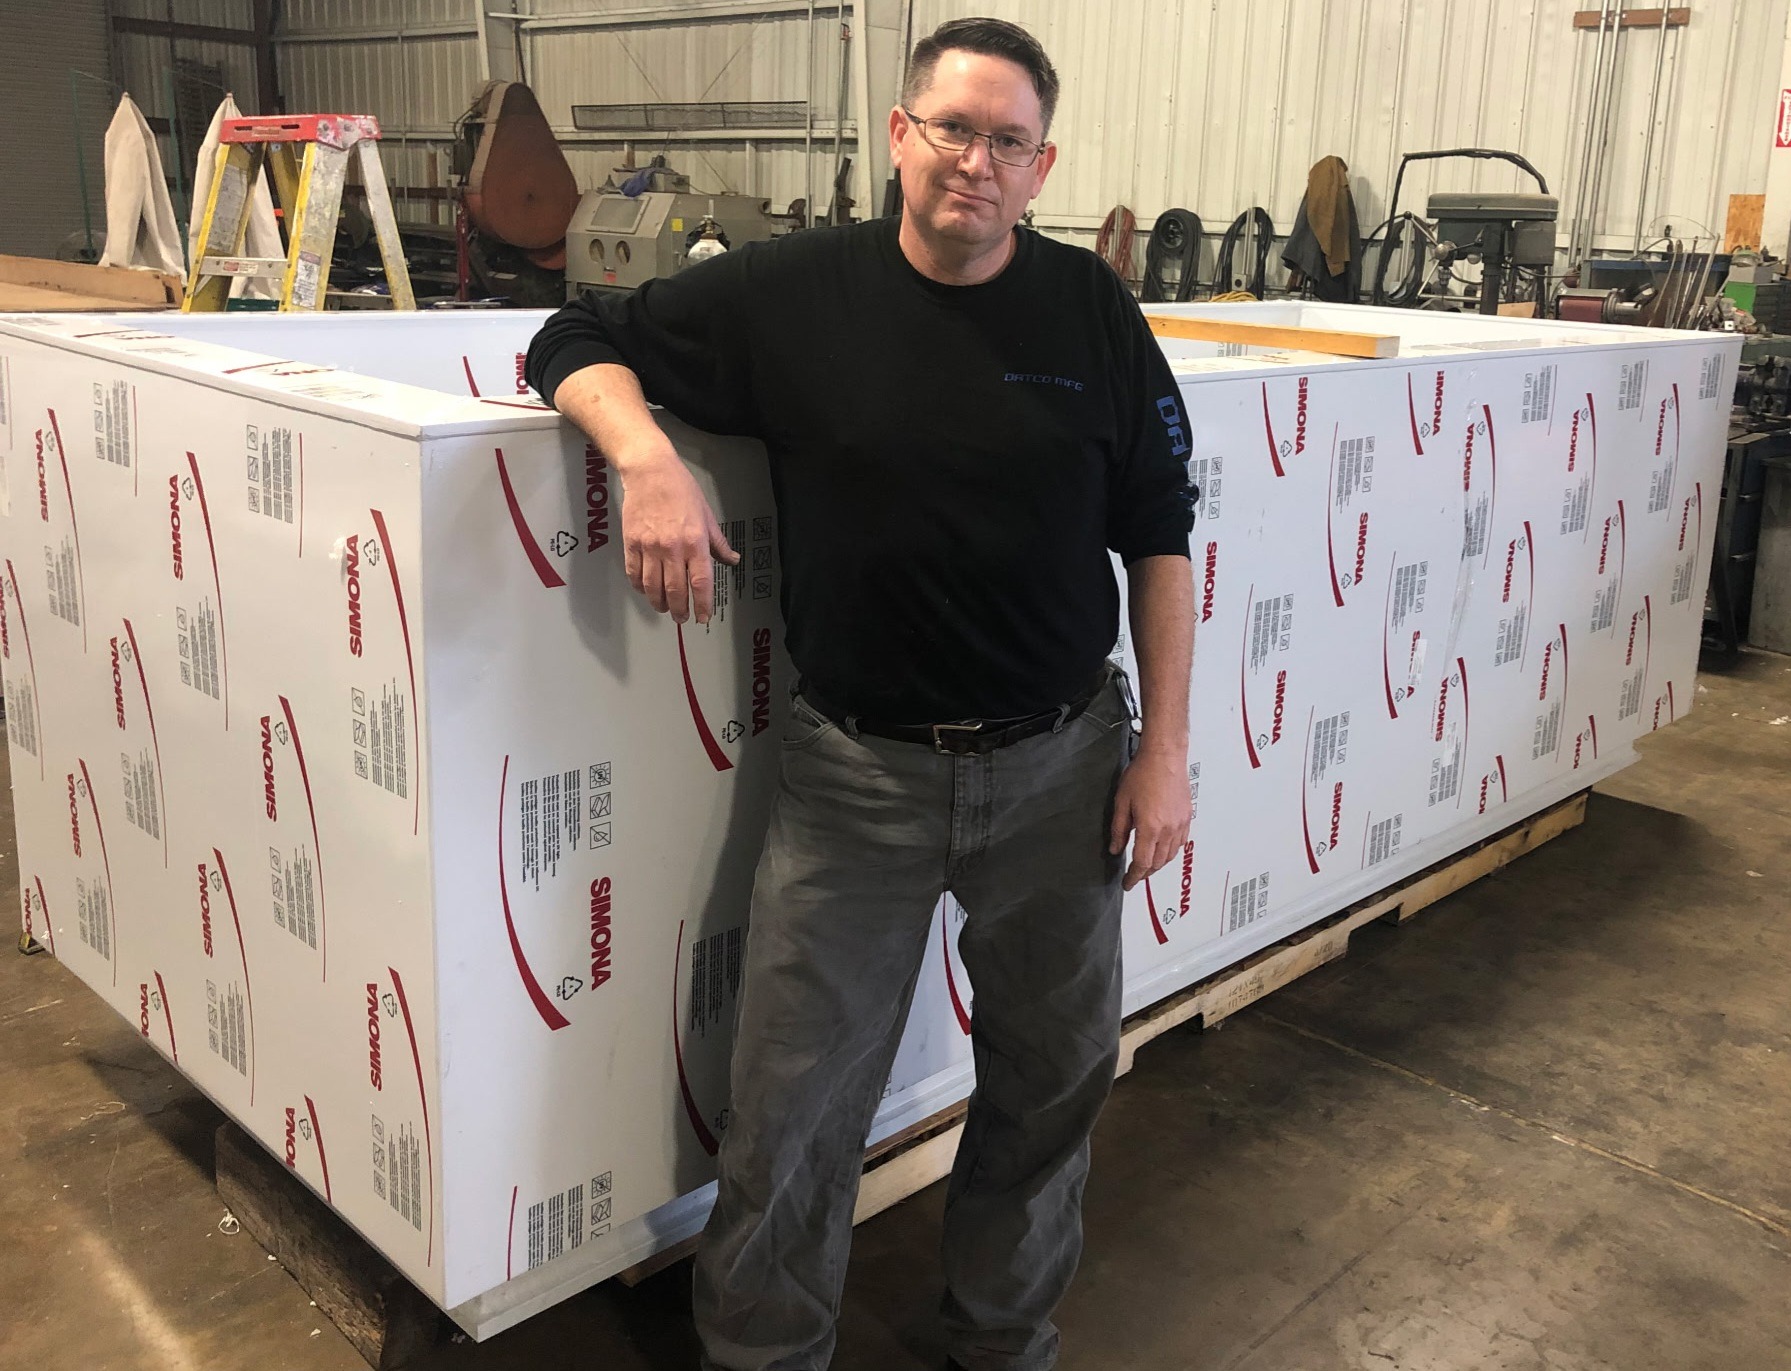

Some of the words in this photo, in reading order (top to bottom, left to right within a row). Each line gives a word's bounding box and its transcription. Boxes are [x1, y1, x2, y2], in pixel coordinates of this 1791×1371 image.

[1004, 373, 1051, 384] DATCO
[1055, 377, 1084, 392] MFG
[1295, 377, 1308, 455] SIMONA
[1463, 423, 1475, 493] SIMONA
[1568, 410, 1579, 471] SIMONA
[1656, 399, 1666, 455] SIMONA
[35, 428, 48, 522] SIMONA
[168, 475, 183, 580] SIMONA
[1354, 512, 1368, 586] SIMONA
[1599, 516, 1612, 575] SIMONA
[346, 535, 362, 657] SIMONA
[1202, 541, 1217, 624] SIMONA
[1503, 539, 1516, 603] SIMONA
[1540, 642, 1552, 701] SIMONA
[1626, 611, 1638, 666] SIMONA
[110, 636, 126, 730] SIMONA
[752, 628, 770, 737] SIMONA
[1272, 670, 1286, 745] SIMONA
[1436, 677, 1449, 742] SIMONA
[260, 716, 277, 821] SIMONA
[67, 773, 82, 857] SIMONA
[1330, 781, 1343, 851] SIMONA
[198, 864, 213, 957] SIMONA
[1180, 840, 1194, 917] SIMONA
[590, 876, 611, 991] SIMONA
[366, 983, 382, 1091] SIMONA
